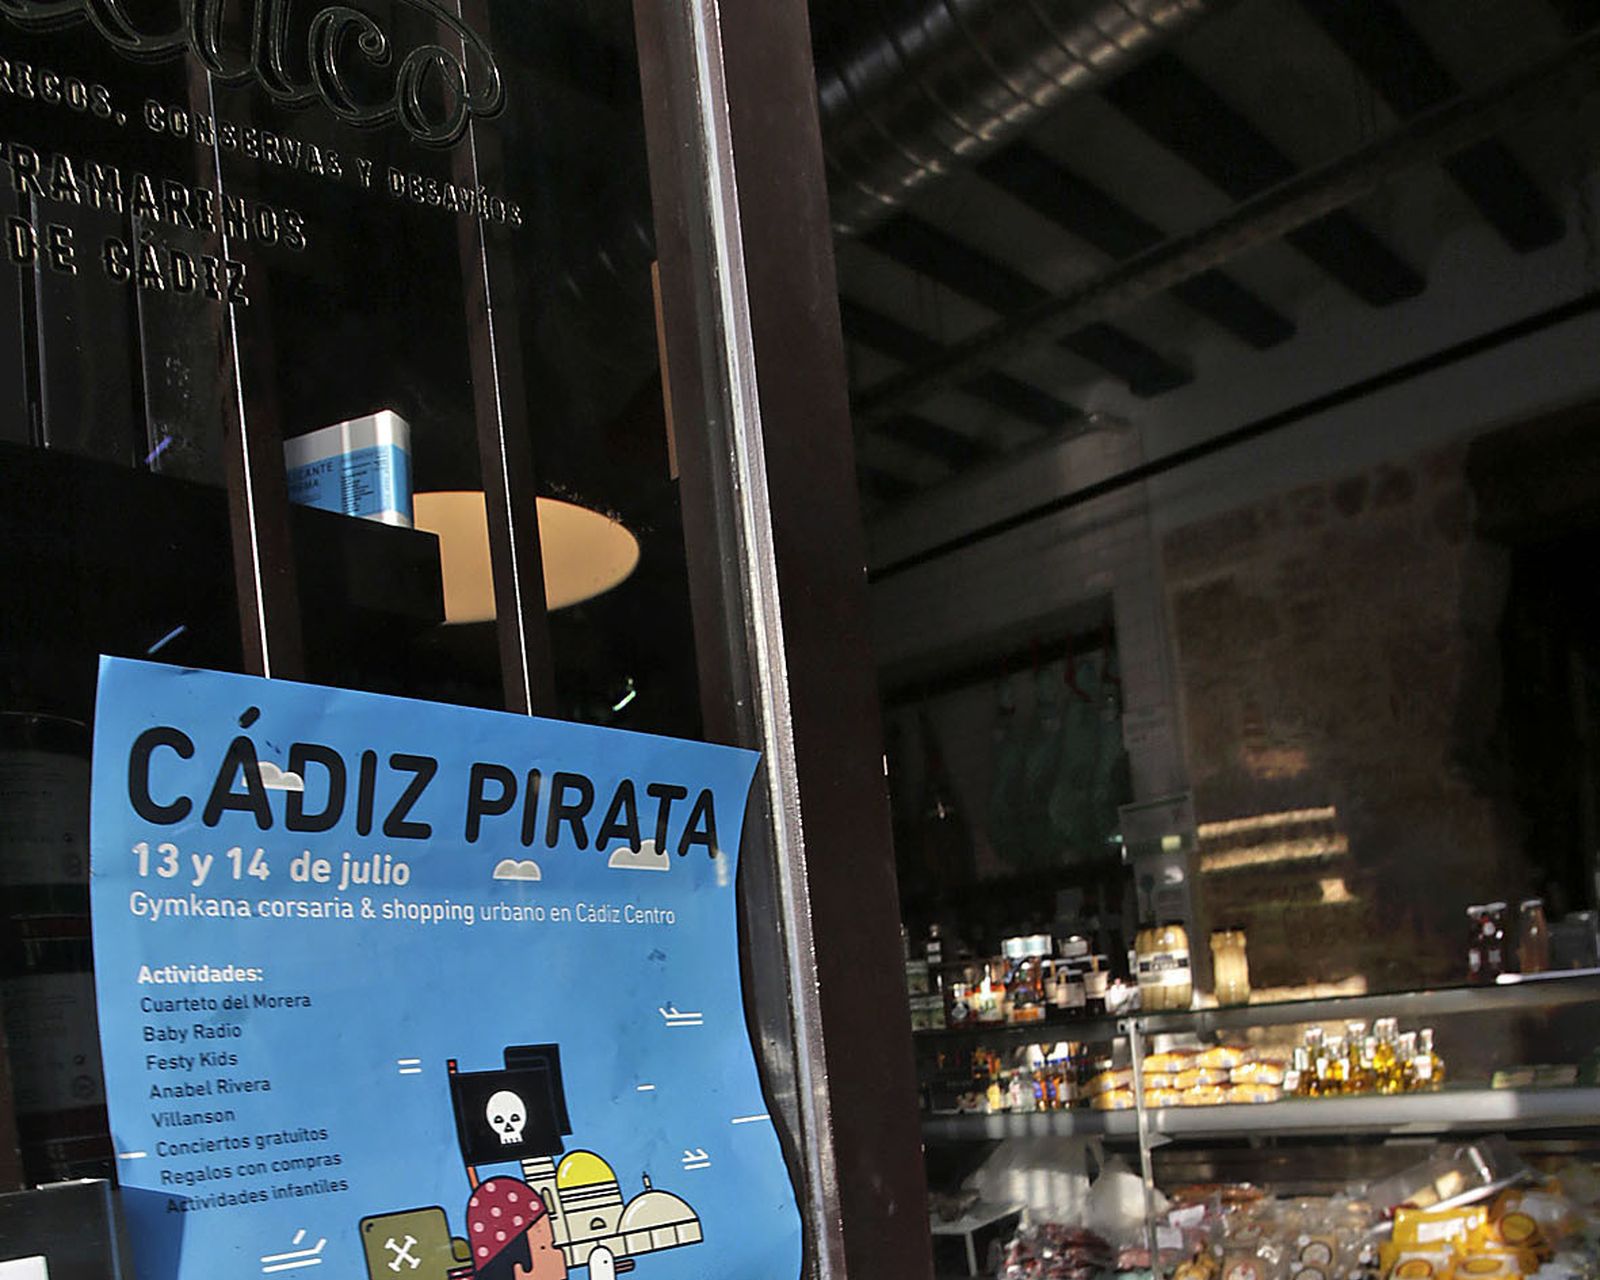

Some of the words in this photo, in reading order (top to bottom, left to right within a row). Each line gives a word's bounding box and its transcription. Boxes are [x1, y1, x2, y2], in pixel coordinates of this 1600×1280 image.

[144, 101, 343, 179] CONSERVAS
[354, 158, 374, 188] Y
[0, 143, 308, 251] RAMARINOS
[6, 214, 78, 276] DE
[102, 228, 250, 307] CÁDIZ
[127, 706, 439, 840] CÁDIZ
[465, 761, 720, 860] PIRATA
[132, 842, 179, 879] 13
[190, 850, 214, 888] y
[226, 847, 271, 882] 14
[289, 850, 333, 882] de
[337, 852, 412, 891] julio
[130, 891, 252, 926] Gymkana
[257, 897, 355, 920] corsaria
[360, 899, 377, 920] &
[381, 899, 476, 926] shopping
[479, 902, 546, 923] urbano
[549, 907, 572, 923] en
[574, 900, 621, 925] Cádiz
[624, 904, 676, 926] Centro
[136, 965, 264, 985] Actividades:
[140, 995, 218, 1014] Cuarteto
[222, 994, 250, 1010] del
[253, 993, 312, 1010] Morera
[144, 1025, 188, 1044] Baby
[193, 1022, 242, 1039] Radio
[146, 1053, 196, 1072] Festy
[200, 1051, 238, 1067] Kids
[149, 1079, 213, 1100] Anabel
[218, 1077, 272, 1095] Rivera
[151, 1108, 236, 1129] Villanson
[155, 1134, 251, 1158] Conciertos
[254, 1125, 329, 1150] gratuitos
[160, 1163, 233, 1187] Regalos
[236, 1158, 268, 1177] con
[271, 1151, 342, 1177] compras
[166, 1187, 269, 1214] Actividades
[272, 1177, 349, 1201] infantiles
